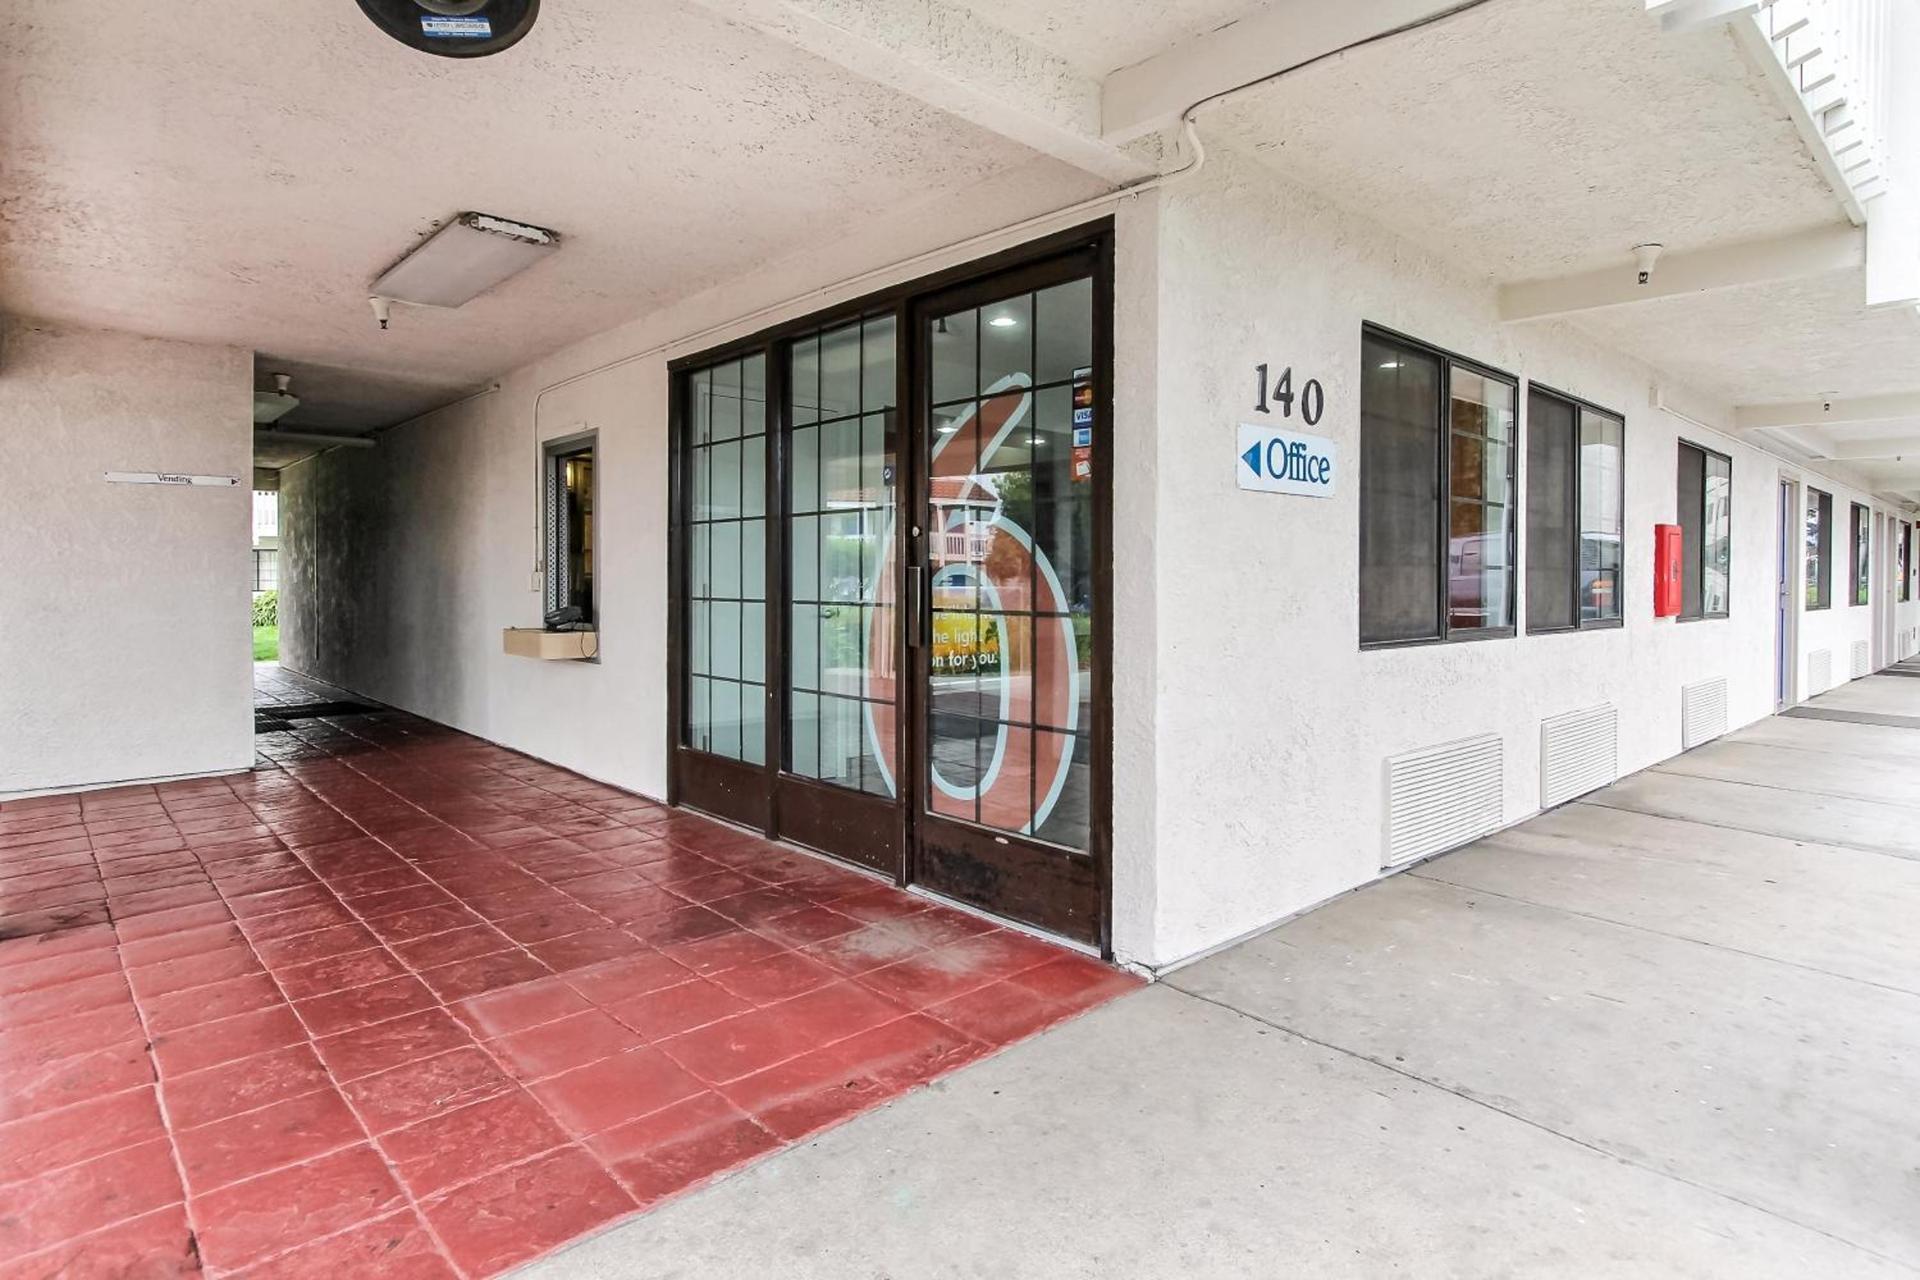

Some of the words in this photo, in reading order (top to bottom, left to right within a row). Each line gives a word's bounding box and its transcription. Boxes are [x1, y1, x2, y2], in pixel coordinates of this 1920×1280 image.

[1255, 363, 1324, 426] 140
[1267, 438, 1331, 485] Office
[158, 474, 193, 486] Vending
[932, 628, 950, 644] he
[949, 650, 969, 667] for
